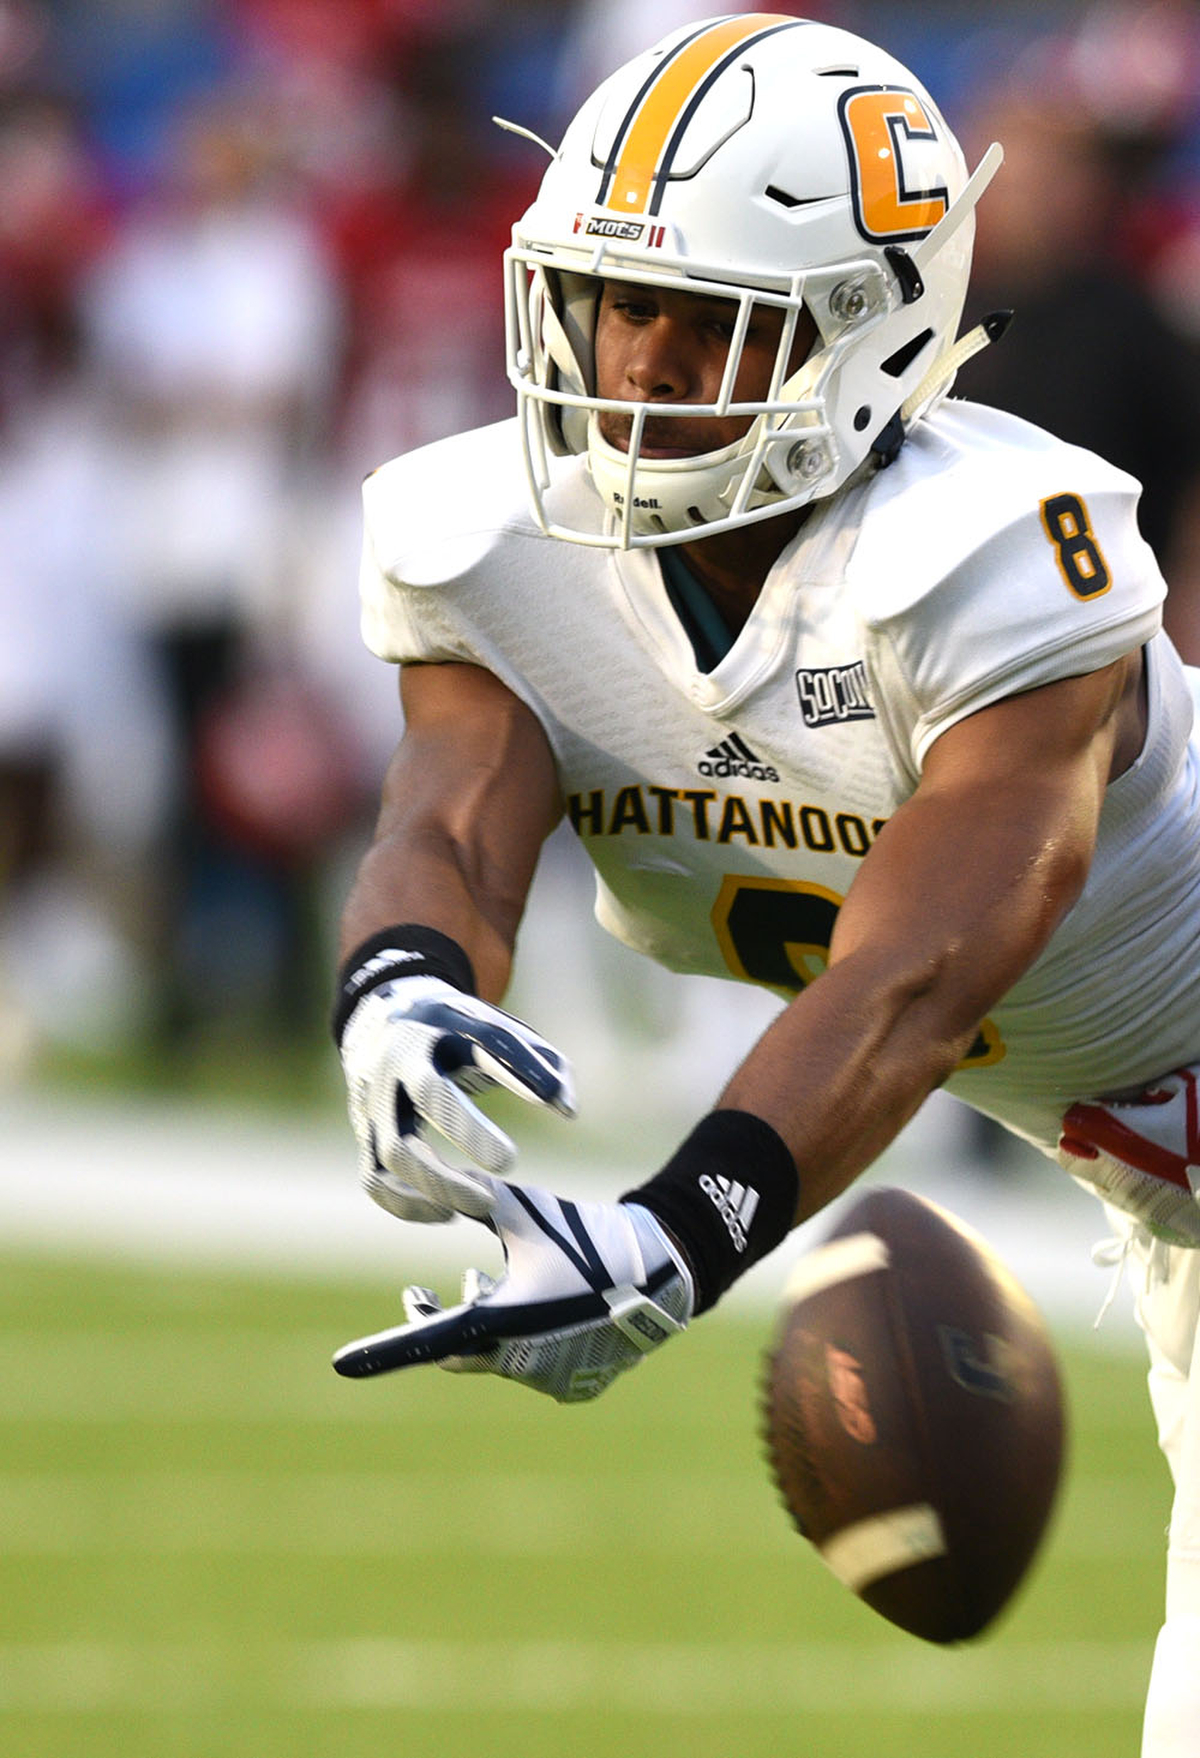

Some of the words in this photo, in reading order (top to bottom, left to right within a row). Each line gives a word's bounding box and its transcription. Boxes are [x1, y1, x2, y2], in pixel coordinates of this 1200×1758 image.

[837, 84, 949, 245] C
[588, 220, 642, 239] MOCS
[613, 491, 659, 509] Ridell
[1038, 491, 1113, 602] 8
[698, 756, 780, 783] adidas
[567, 784, 890, 859] HATTANOO
[698, 1173, 749, 1254] adidas
